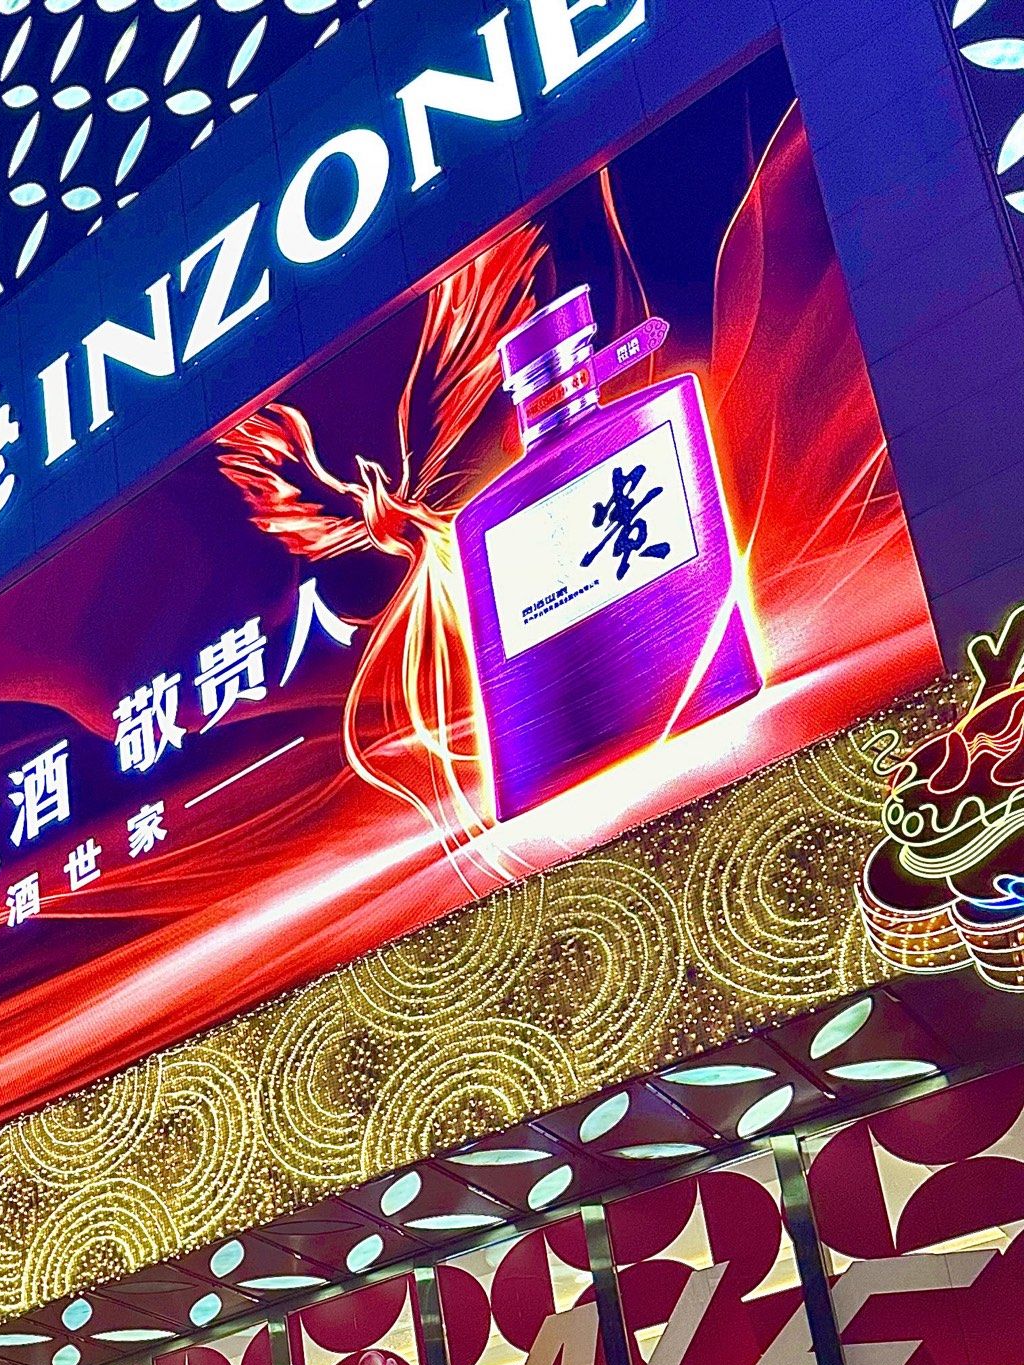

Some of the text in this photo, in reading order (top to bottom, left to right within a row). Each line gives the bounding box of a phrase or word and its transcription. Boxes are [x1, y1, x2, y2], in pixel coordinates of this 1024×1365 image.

[37, 0, 646, 464] INZONE
[112, 577, 359, 773] 敬贵人
